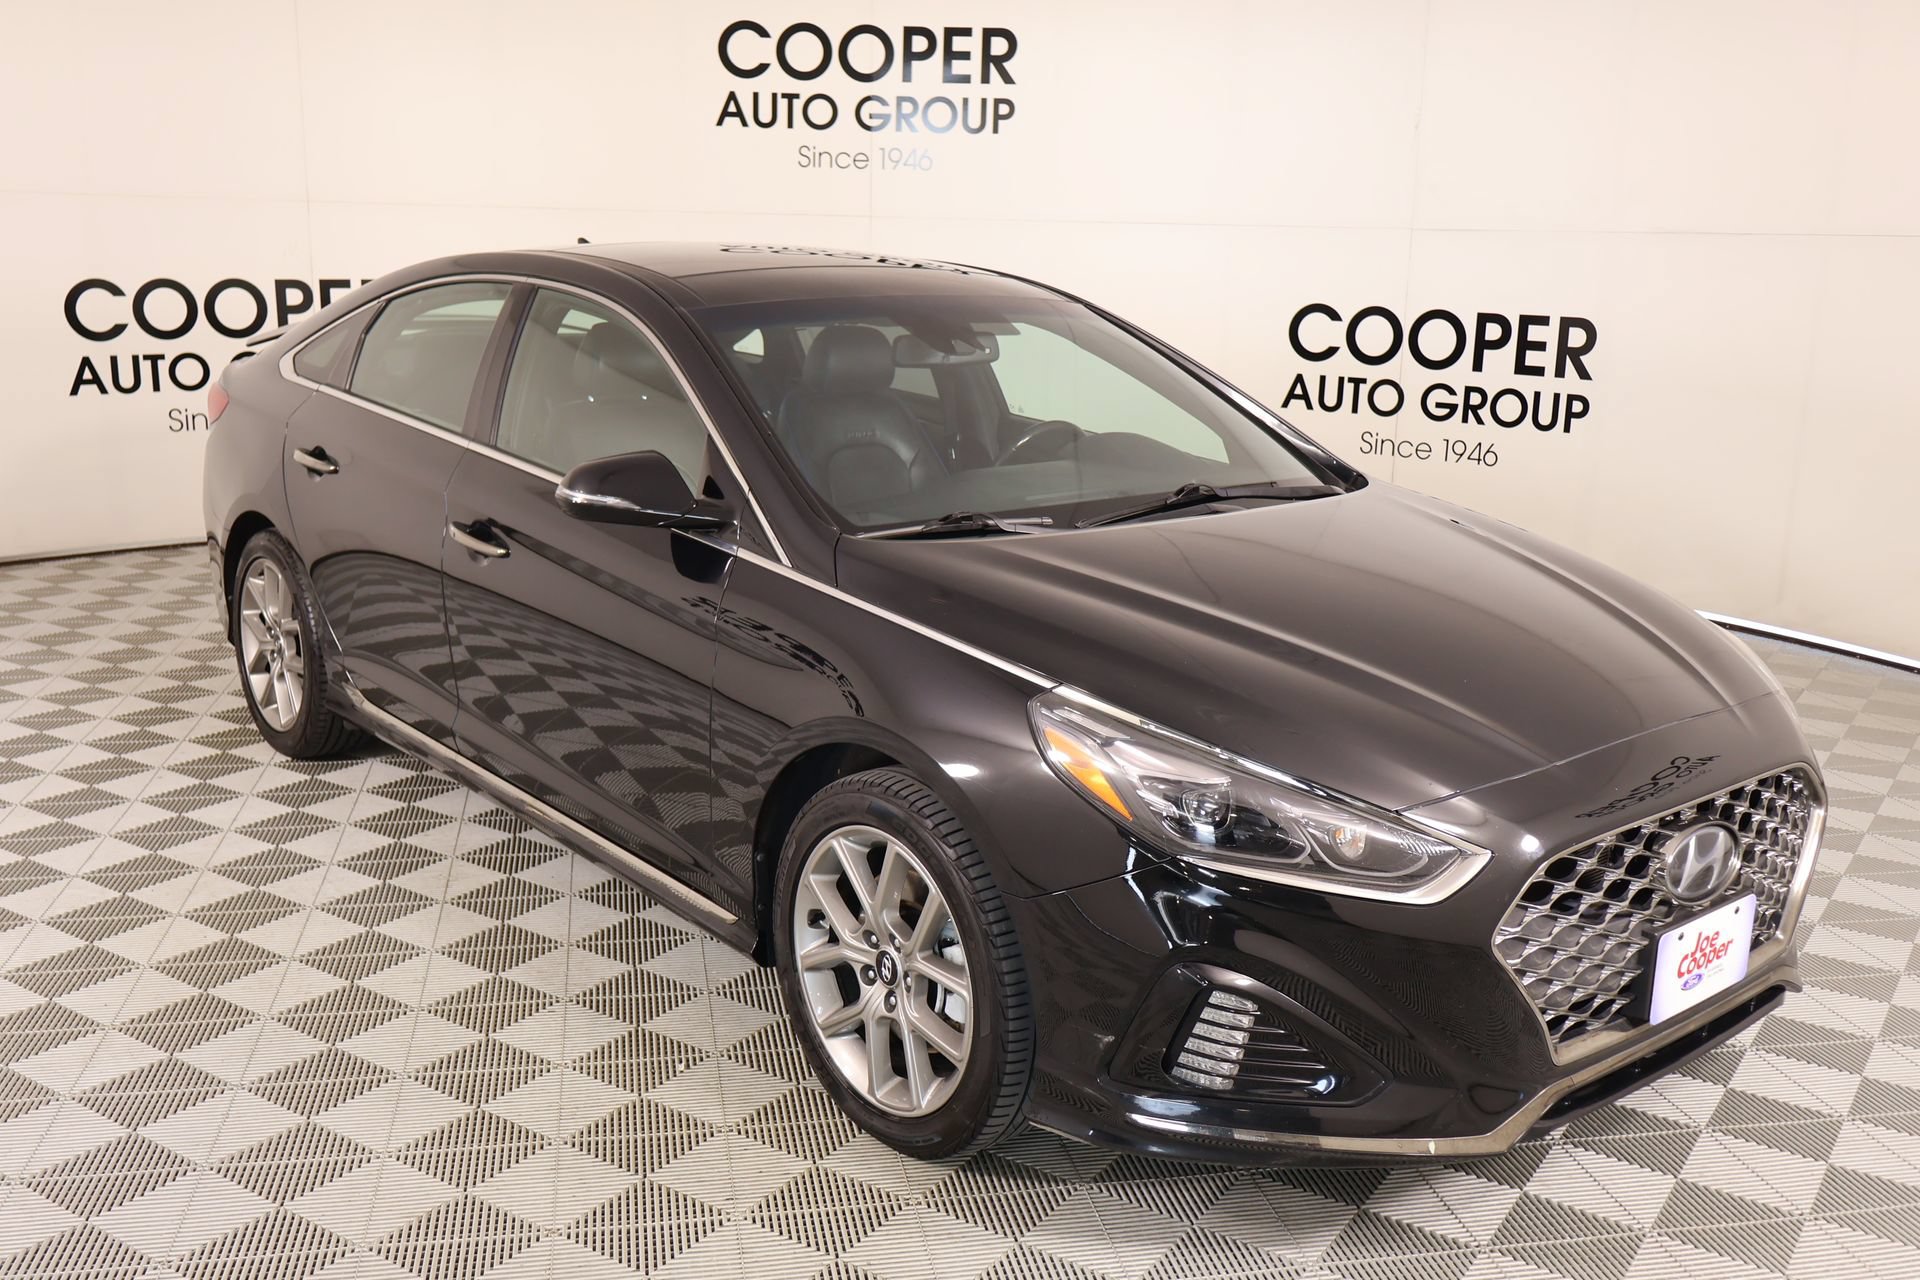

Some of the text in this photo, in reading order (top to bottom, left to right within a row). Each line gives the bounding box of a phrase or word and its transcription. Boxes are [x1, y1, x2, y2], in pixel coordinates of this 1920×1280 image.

[717, 20, 1018, 85] COOPER
[716, 91, 1016, 134] AUTO GROUP
[798, 145, 933, 171] Since 1946
[64, 278, 376, 342] COOP
[1288, 303, 1598, 381] COOPER
[70, 352, 211, 396] AUTO
[168, 408, 209, 432] Sin
[1281, 373, 1590, 434] AUTO GROUP
[1359, 431, 1499, 467] Since 1946
[1677, 938, 1734, 979] Cooper
[1690, 931, 1720, 958] Joe
